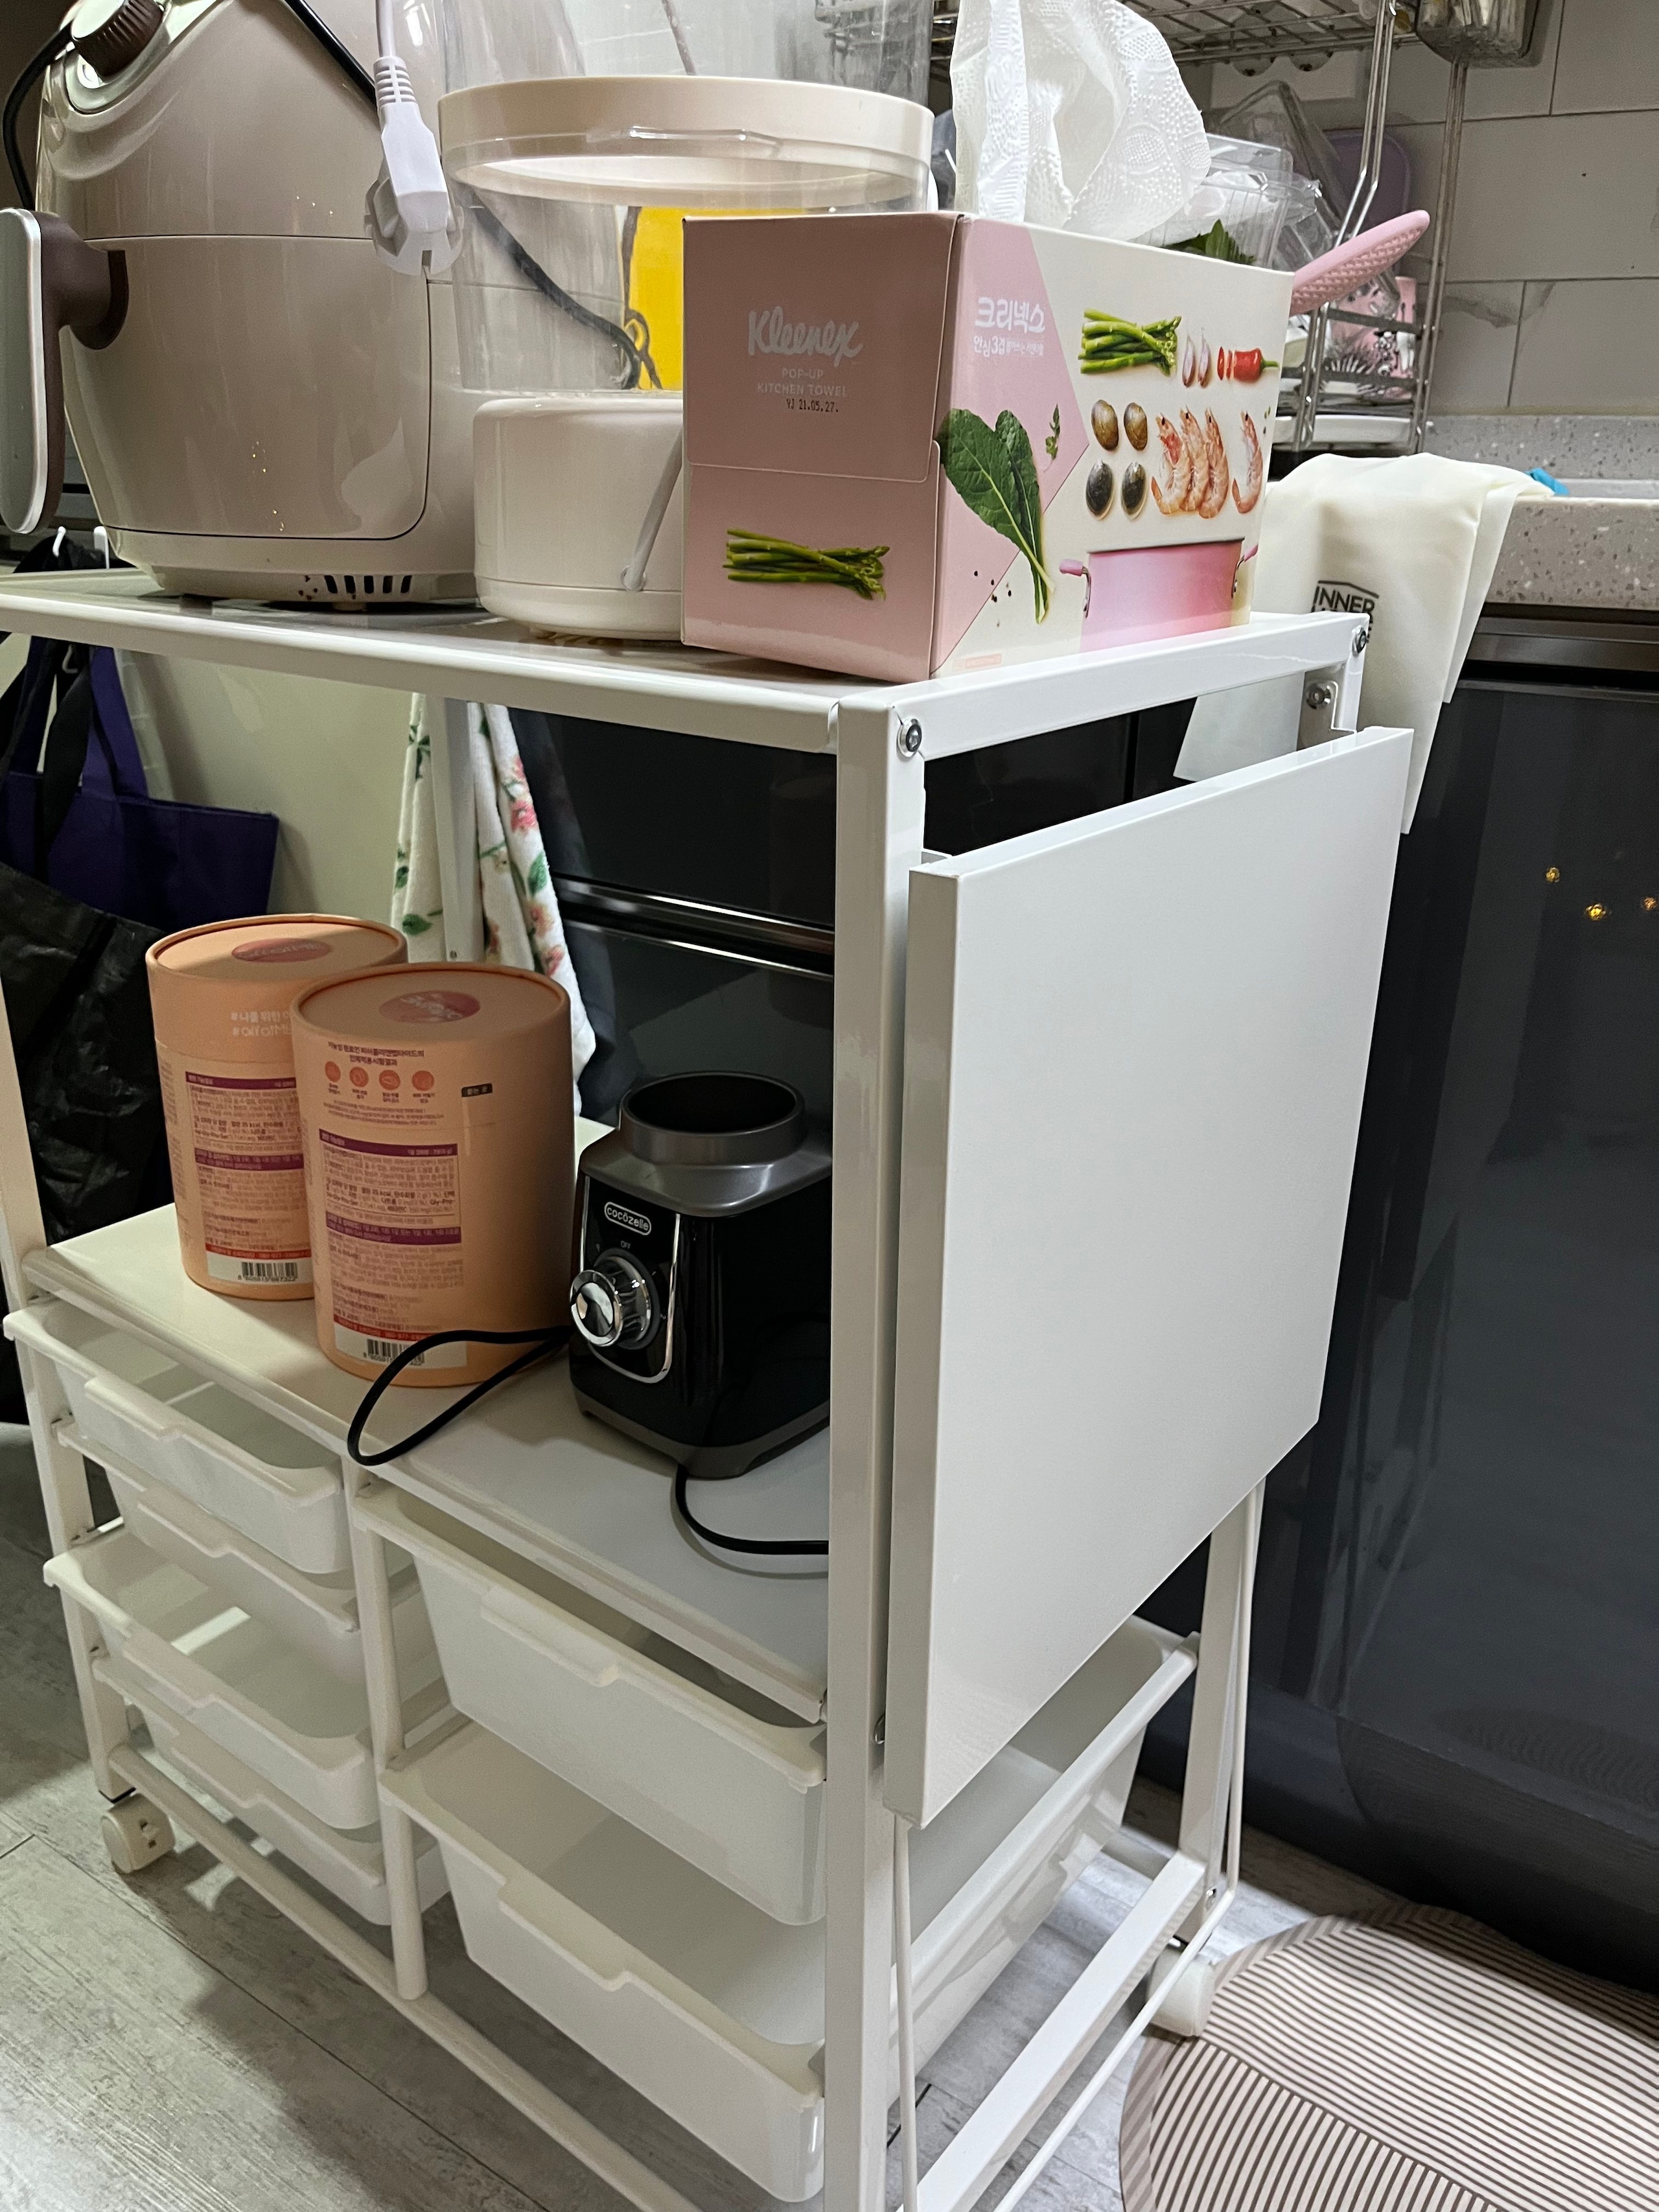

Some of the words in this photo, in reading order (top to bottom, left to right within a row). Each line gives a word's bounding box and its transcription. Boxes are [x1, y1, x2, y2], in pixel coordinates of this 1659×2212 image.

[975, 297, 1045, 334] 크리넥스
[748, 306, 863, 367] Kleenex
[782, 367, 824, 379] POP-UP
[757, 382, 804, 395] KITCHEN
[809, 384, 847, 397] TOWEL
[786, 398, 795, 410] YJ
[798, 399, 839, 413] 21.05.27.
[1313, 586, 1375, 612] INNER
[621, 1240, 631, 1249] OFF
